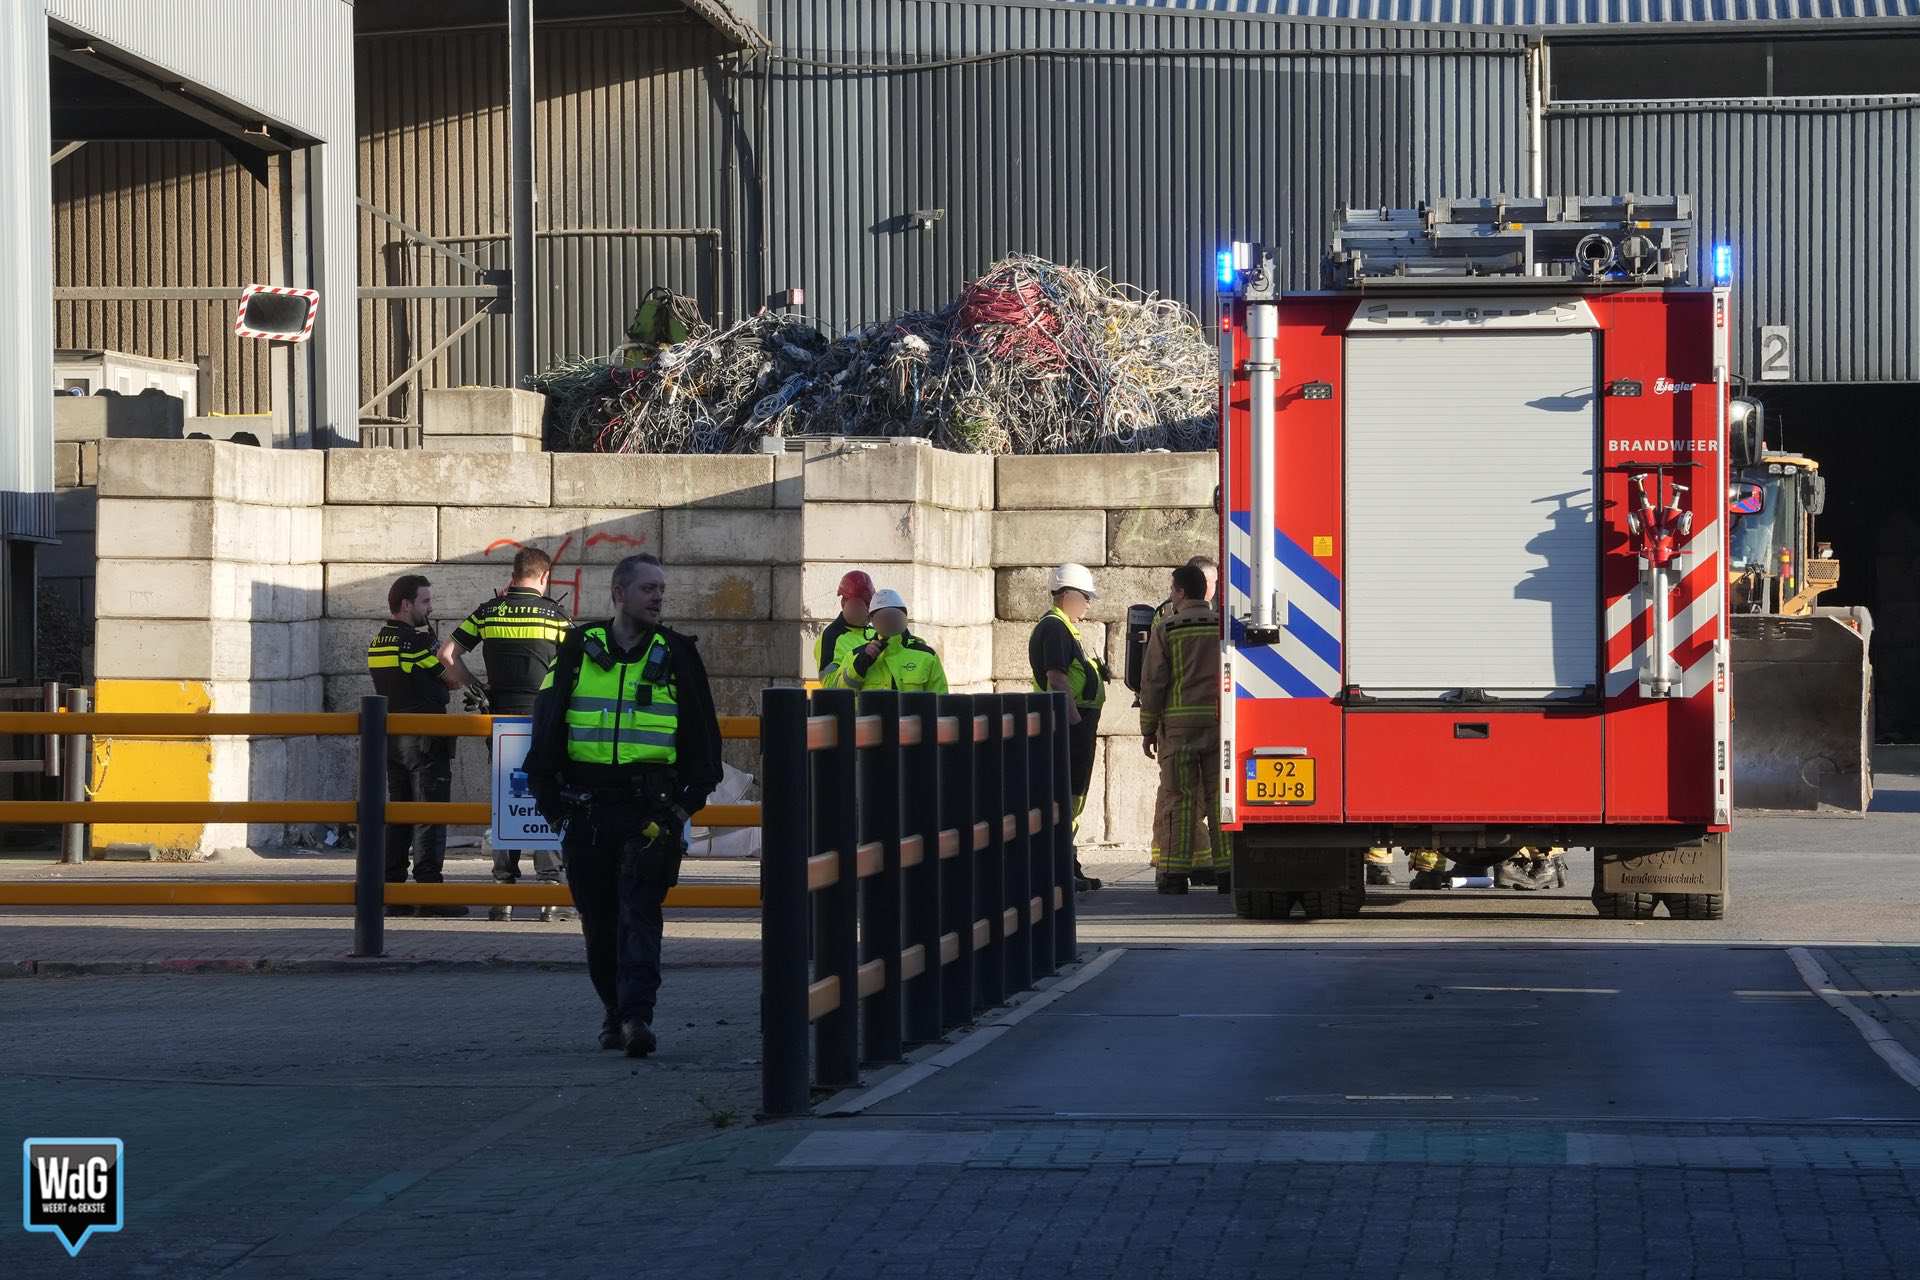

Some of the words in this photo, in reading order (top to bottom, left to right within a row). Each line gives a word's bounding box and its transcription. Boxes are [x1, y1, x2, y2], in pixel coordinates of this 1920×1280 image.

[1762, 334, 1788, 372] 2
[1608, 439, 1718, 452] BRANDWEER
[1273, 761, 1296, 777] 92
[1257, 782, 1304, 798] BJJ-8
[508, 804, 544, 816] Verb
[523, 823, 552, 833] con
